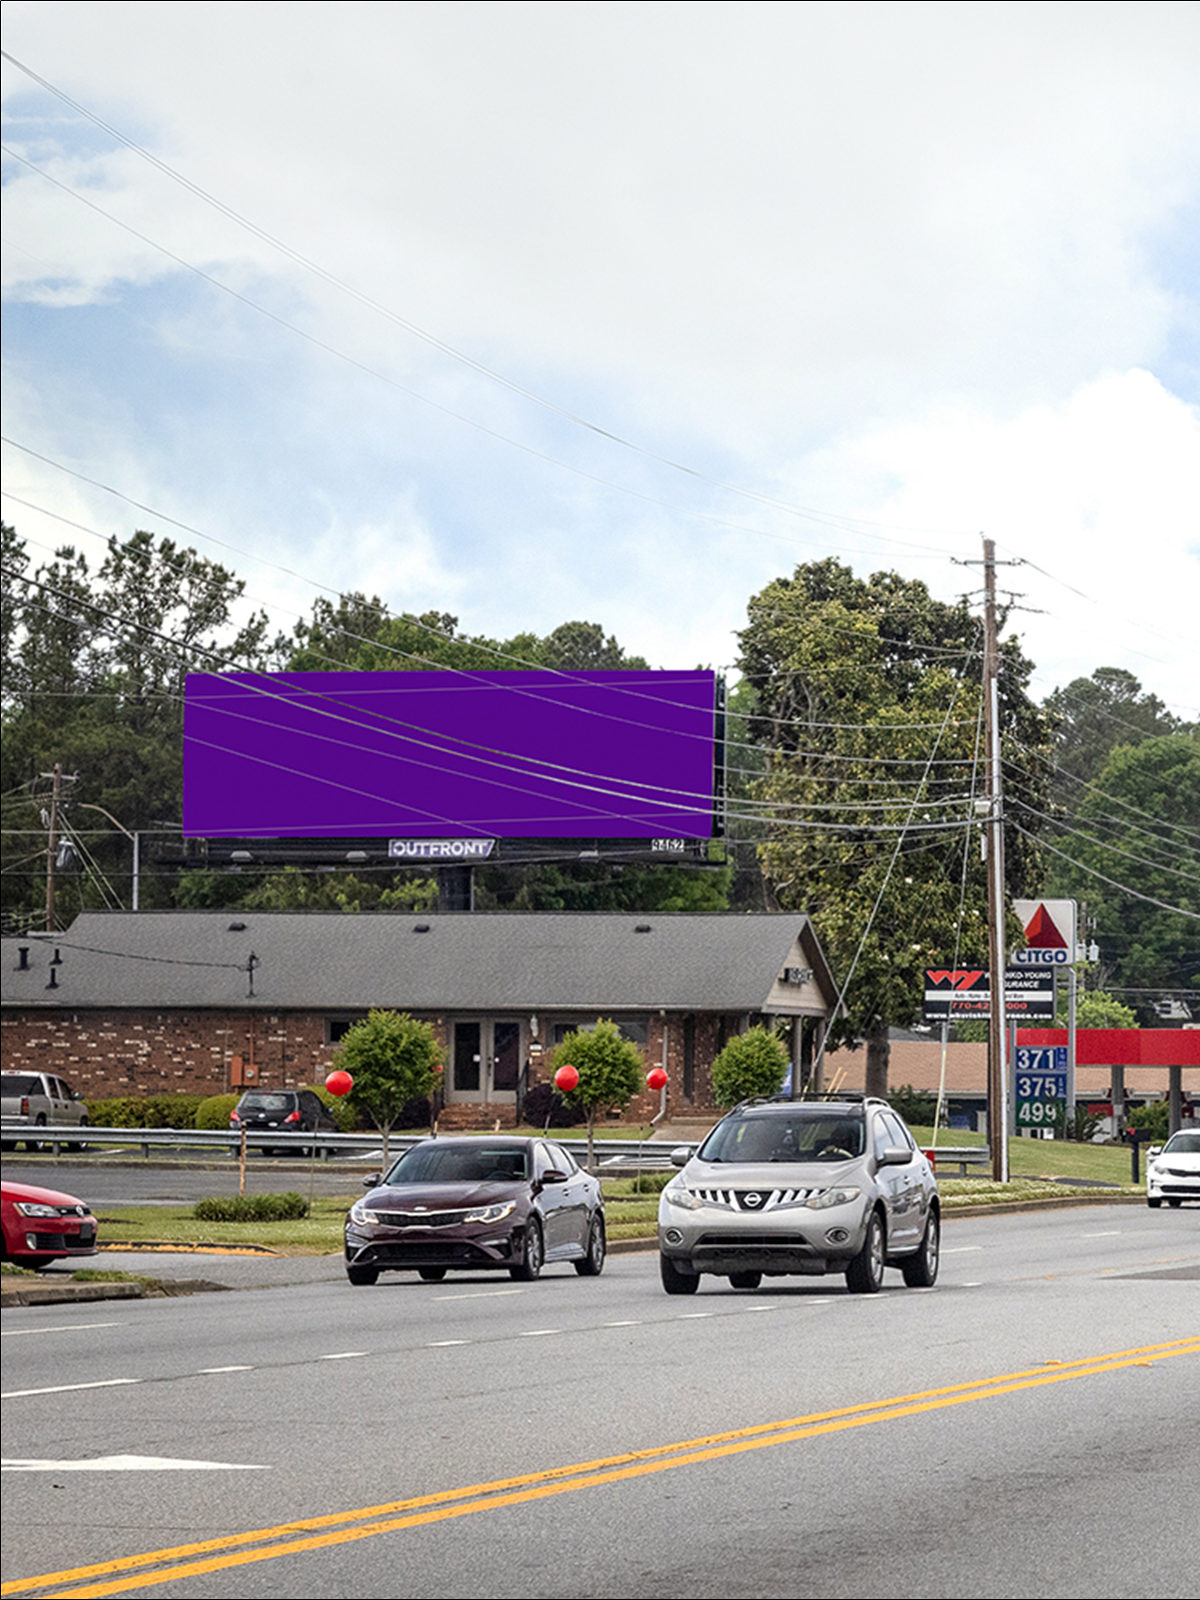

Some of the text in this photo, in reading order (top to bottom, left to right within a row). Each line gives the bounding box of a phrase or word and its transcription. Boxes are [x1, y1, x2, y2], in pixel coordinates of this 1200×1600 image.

[393, 842, 487, 856] OUTFRONT
[1016, 950, 1067, 963] CITGO
[1018, 1049, 1054, 1069] 371
[1019, 1077, 1056, 1097] 375
[1019, 1102, 1056, 1122] 499
